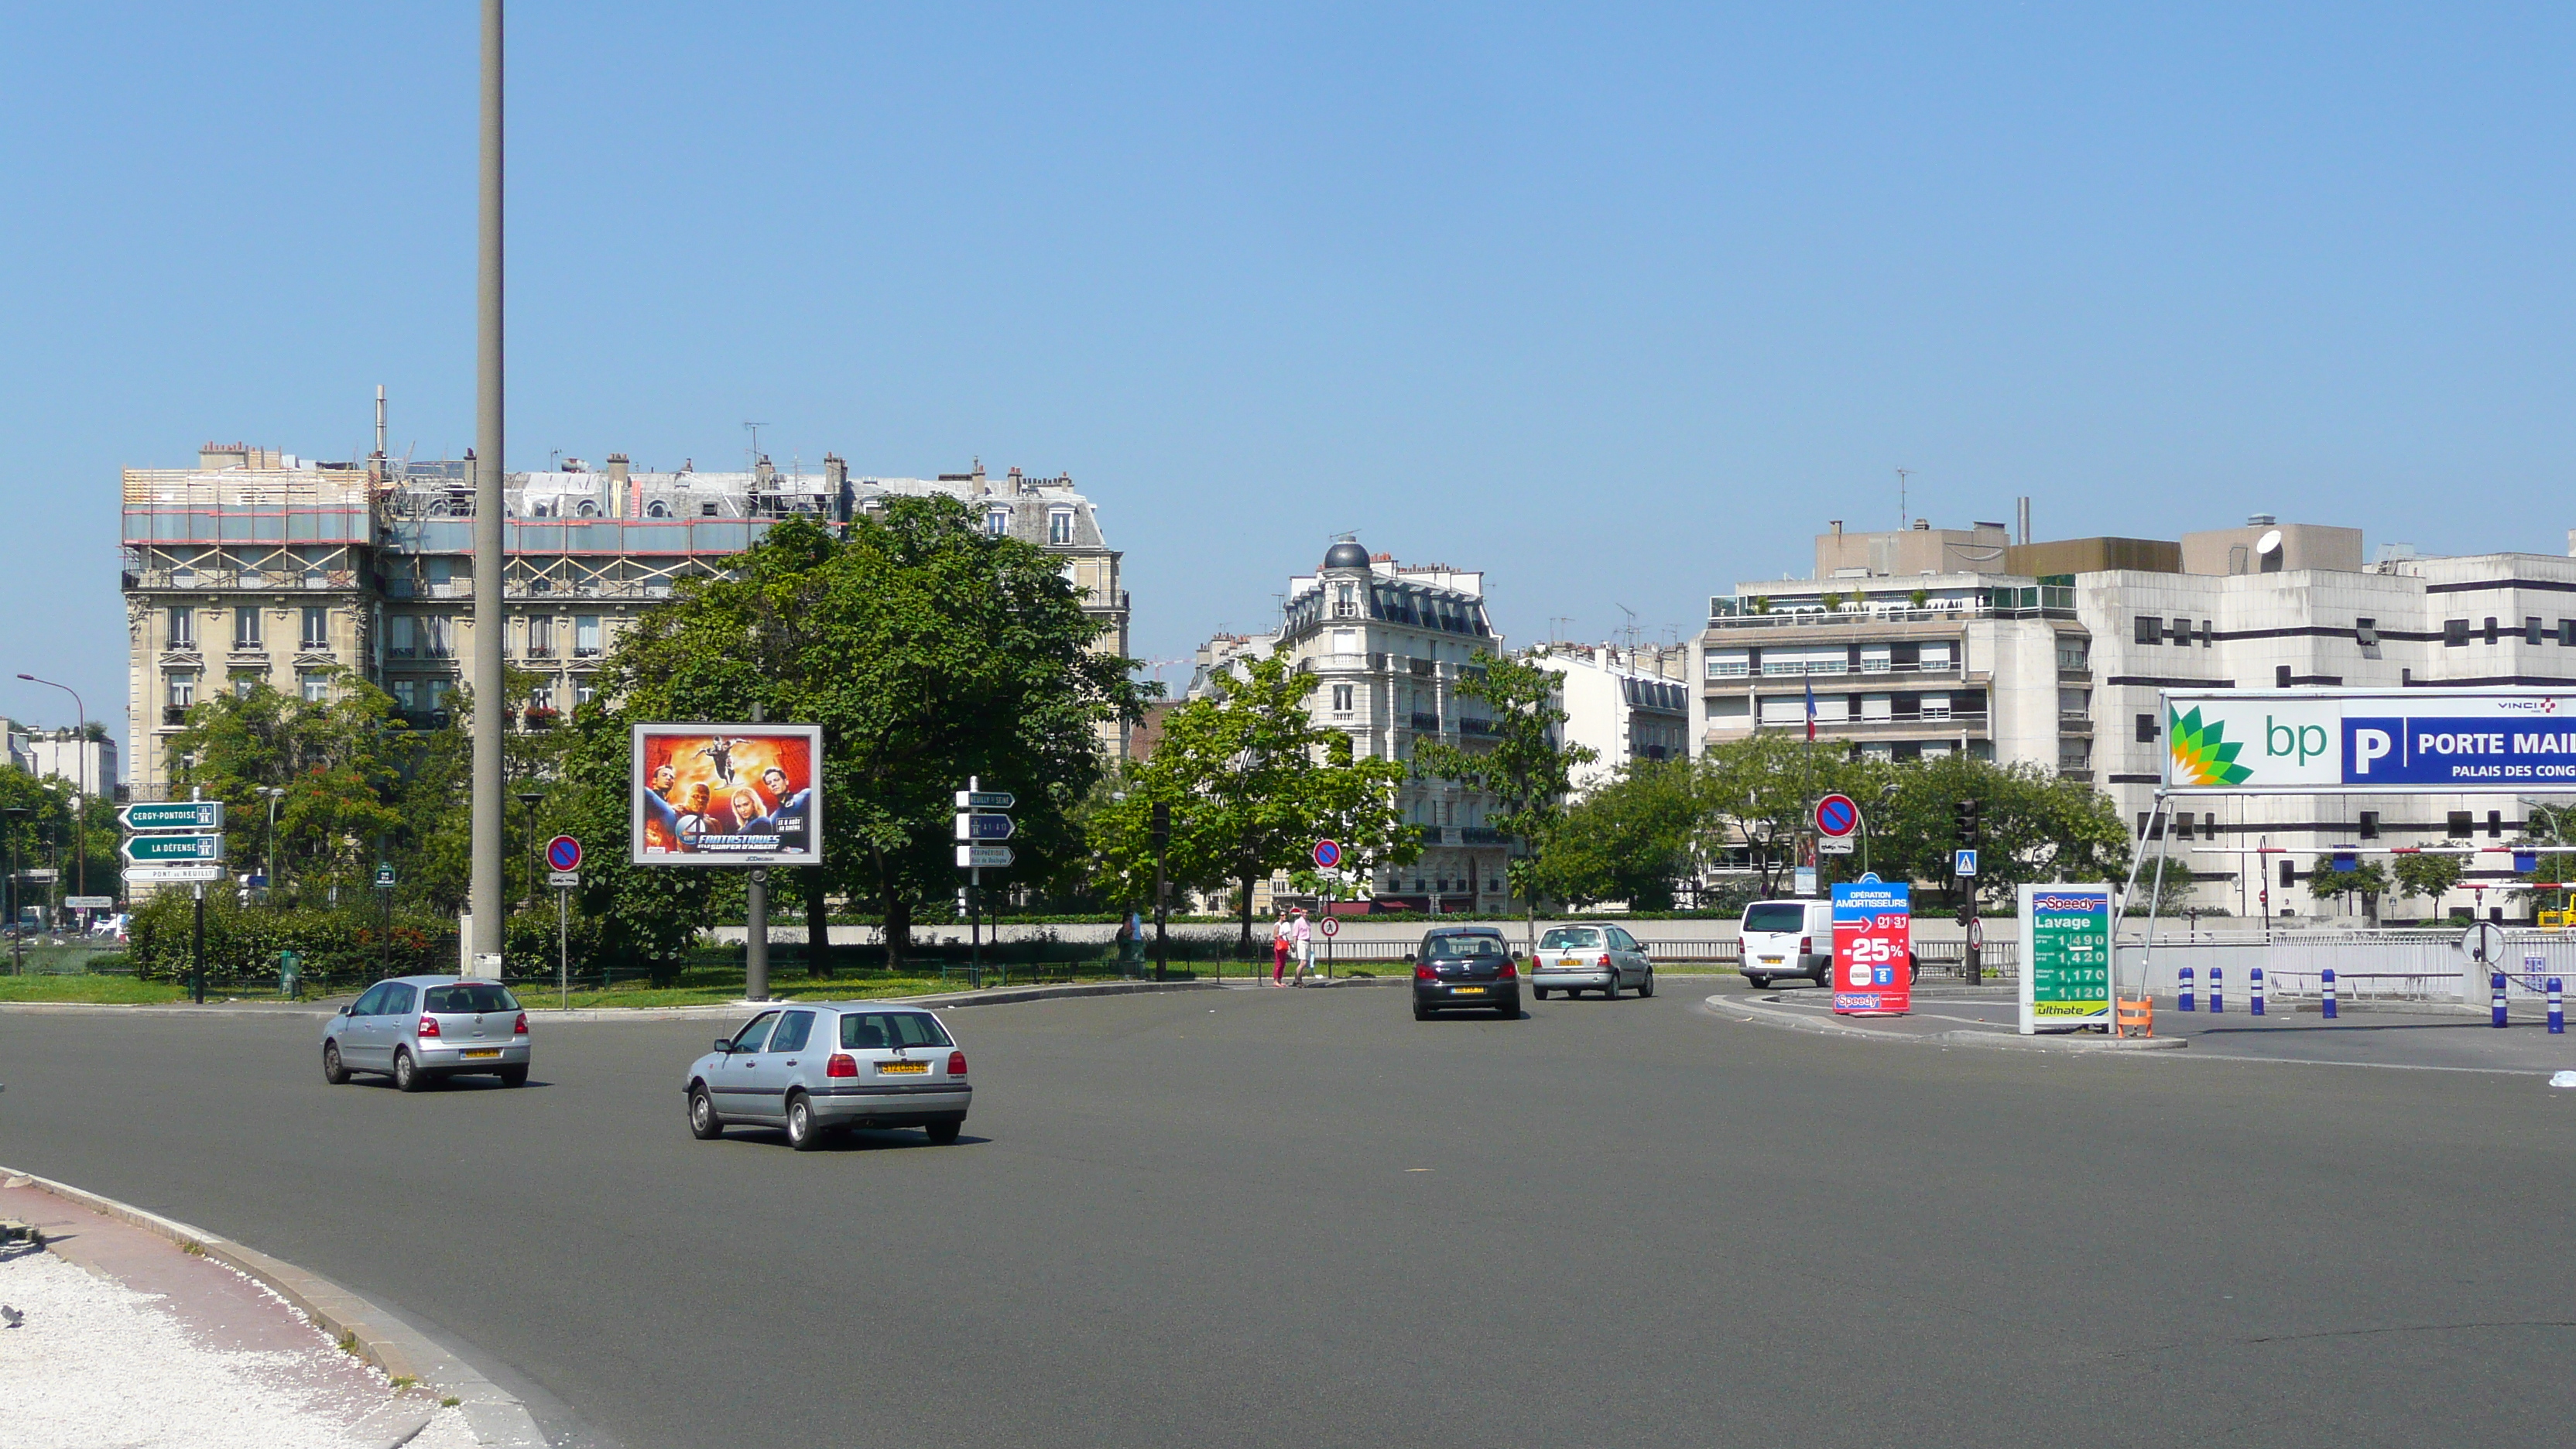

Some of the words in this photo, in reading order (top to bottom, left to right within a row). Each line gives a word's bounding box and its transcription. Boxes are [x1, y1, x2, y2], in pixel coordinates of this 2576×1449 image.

[2266, 714, 2327, 766] bp
[2419, 733, 2505, 755] PORTE
[2355, 729, 2392, 774] P
[2452, 766, 2501, 777] PALAIS
[2505, 766, 2532, 776] DES
[2536, 766, 2576, 776] CONG
[132, 811, 196, 820] CERGY-PONTOISE
[698, 834, 780, 844] FANTASTIQUES
[152, 844, 161, 852] LA
[163, 843, 197, 852] DÉFENSE
[1835, 899, 1907, 908] AMORTISSEURS
[2046, 896, 2095, 911] Speedy
[1877, 916, 1889, 926] 01
[1893, 916, 1906, 926] 31
[2034, 916, 2091, 930] Lavage
[1838, 995, 1877, 1008] Speedy
[2038, 1005, 2084, 1015] ultimate
